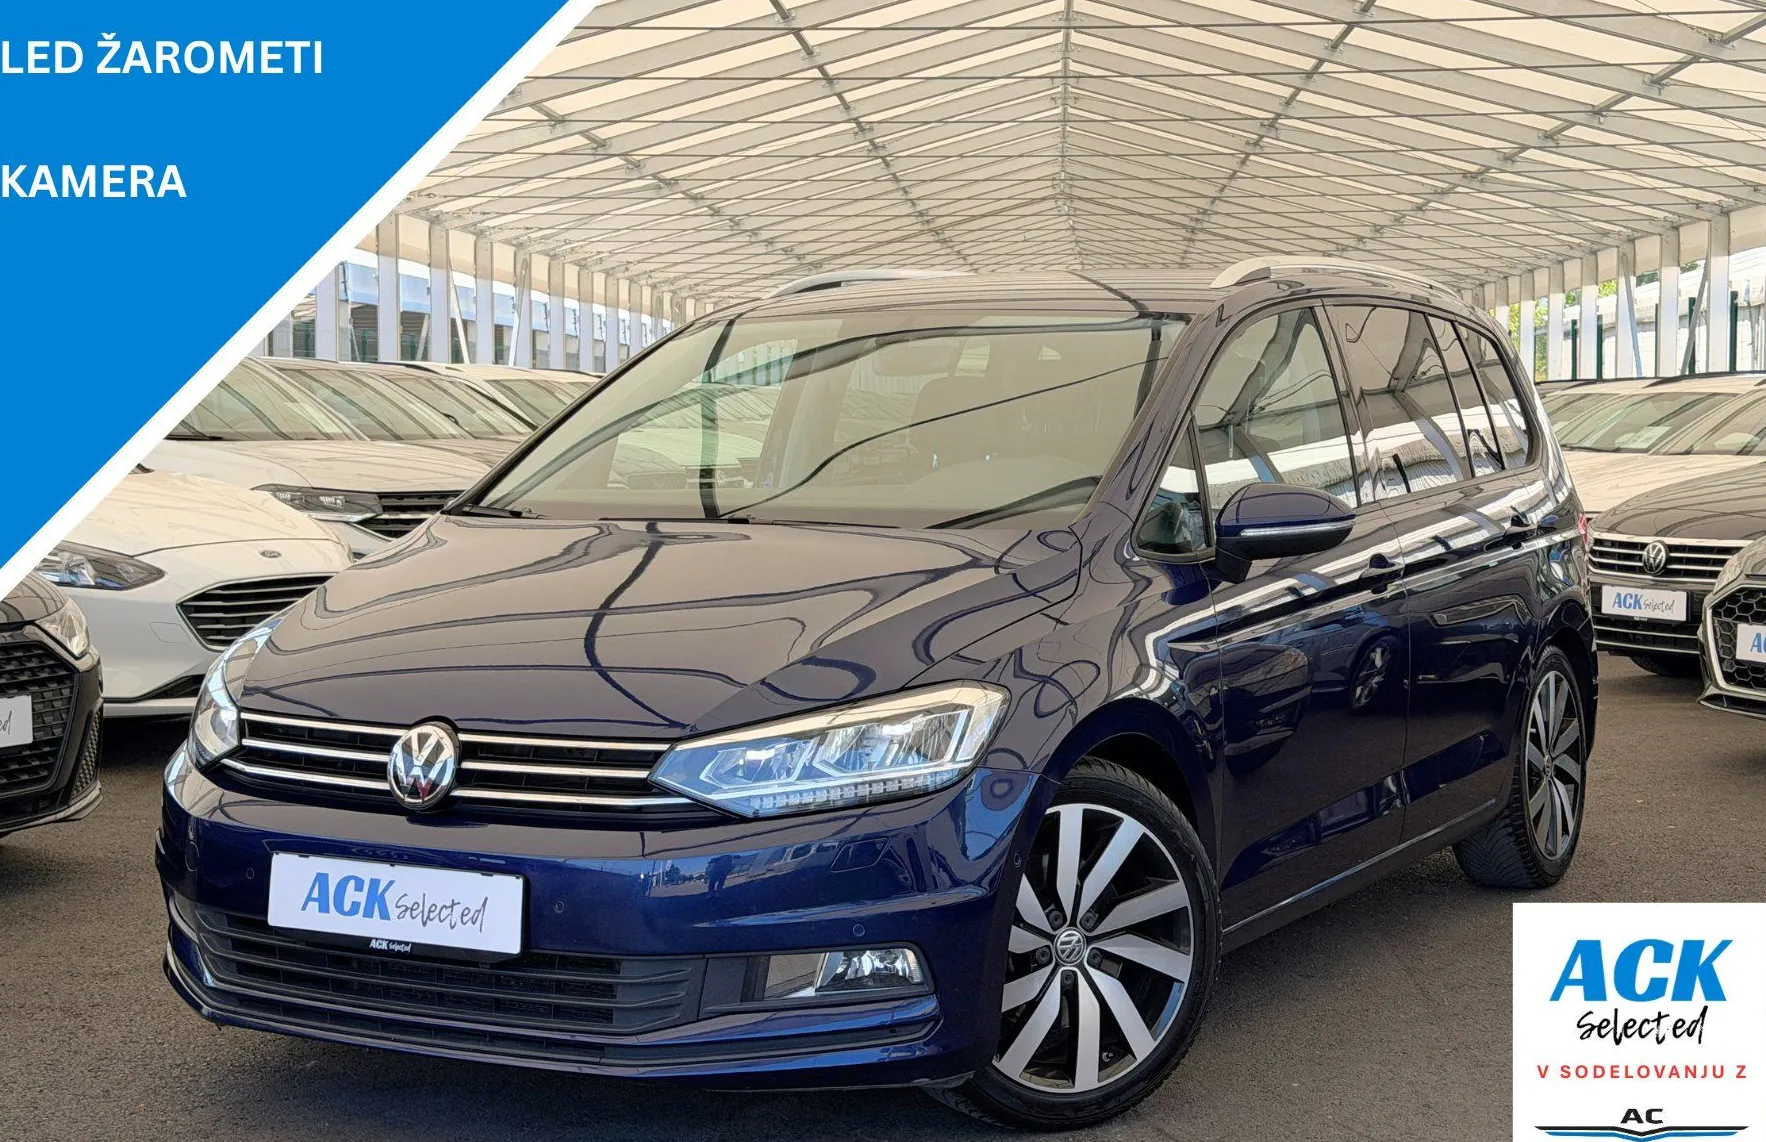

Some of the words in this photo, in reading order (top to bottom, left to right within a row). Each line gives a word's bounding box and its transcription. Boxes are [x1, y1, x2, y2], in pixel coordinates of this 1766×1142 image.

[1612, 592, 1643, 610] ACK
[1750, 633, 1766, 653] A
[301, 872, 396, 921] ACK
[395, 893, 489, 933] Selected
[369, 938, 389, 950] ACK
